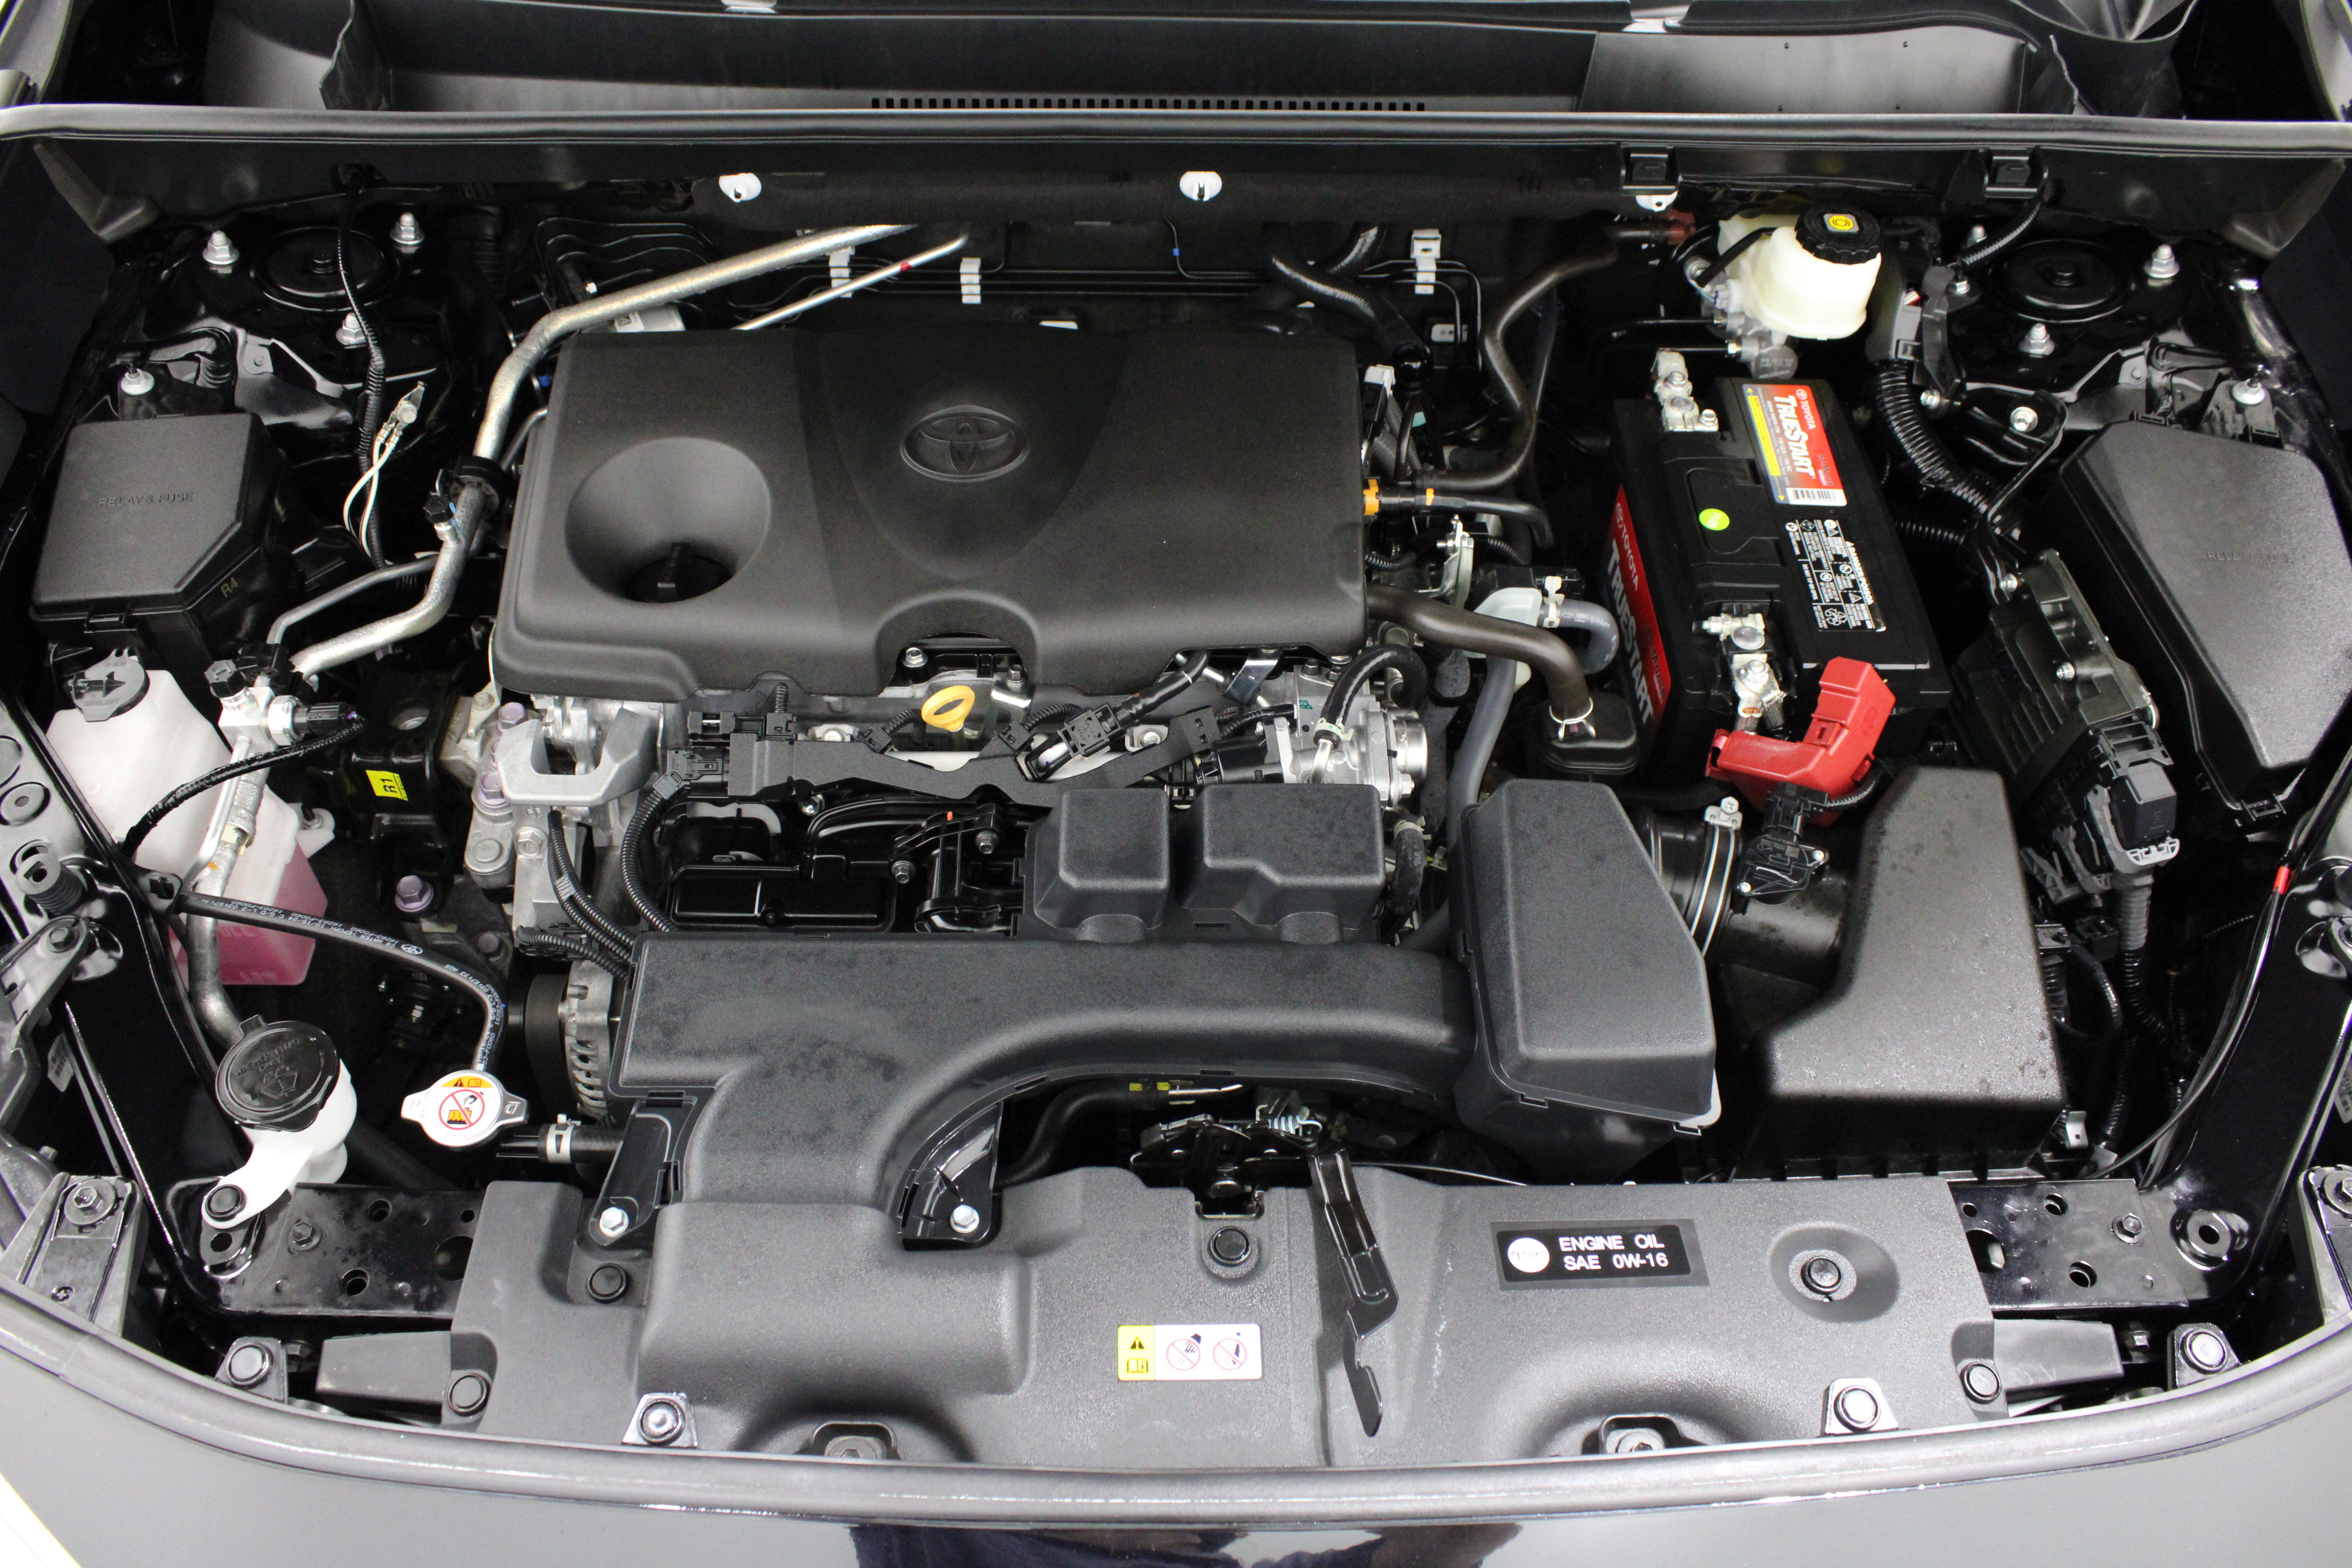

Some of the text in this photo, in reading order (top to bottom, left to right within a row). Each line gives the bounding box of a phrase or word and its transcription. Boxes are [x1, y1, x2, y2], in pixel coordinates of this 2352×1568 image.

[1800, 401, 1816, 429] TOYOTA
[1621, 523, 1639, 592] TOYOTA
[220, 576, 239, 597] R4
[383, 775, 397, 795] R1
[359, 933, 383, 944] WATER
[1559, 1234, 1665, 1252] ENGINE OIL
[1564, 1253, 1669, 1271] SAE 0W-16
